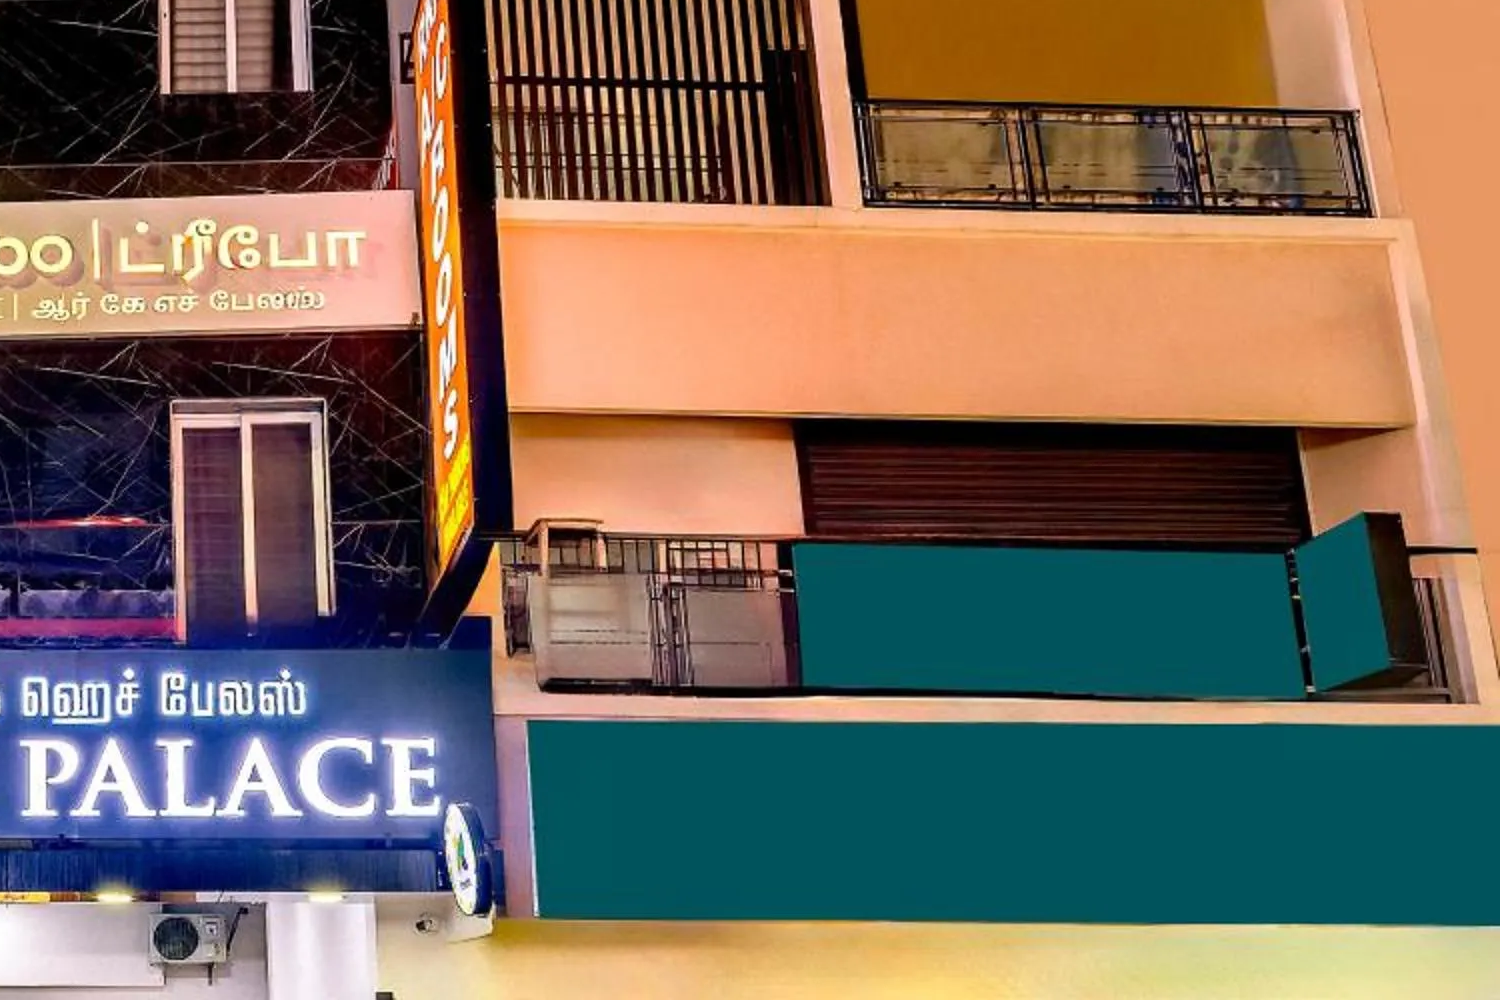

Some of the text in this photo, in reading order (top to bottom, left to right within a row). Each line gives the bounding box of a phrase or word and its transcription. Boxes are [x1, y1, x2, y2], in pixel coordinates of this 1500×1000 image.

[31, 291, 91, 323] ஆர்
[431, 119, 458, 460] ROOMS
[161, 668, 307, 717] பேலஸ்
[19, 735, 443, 818] PALACE
